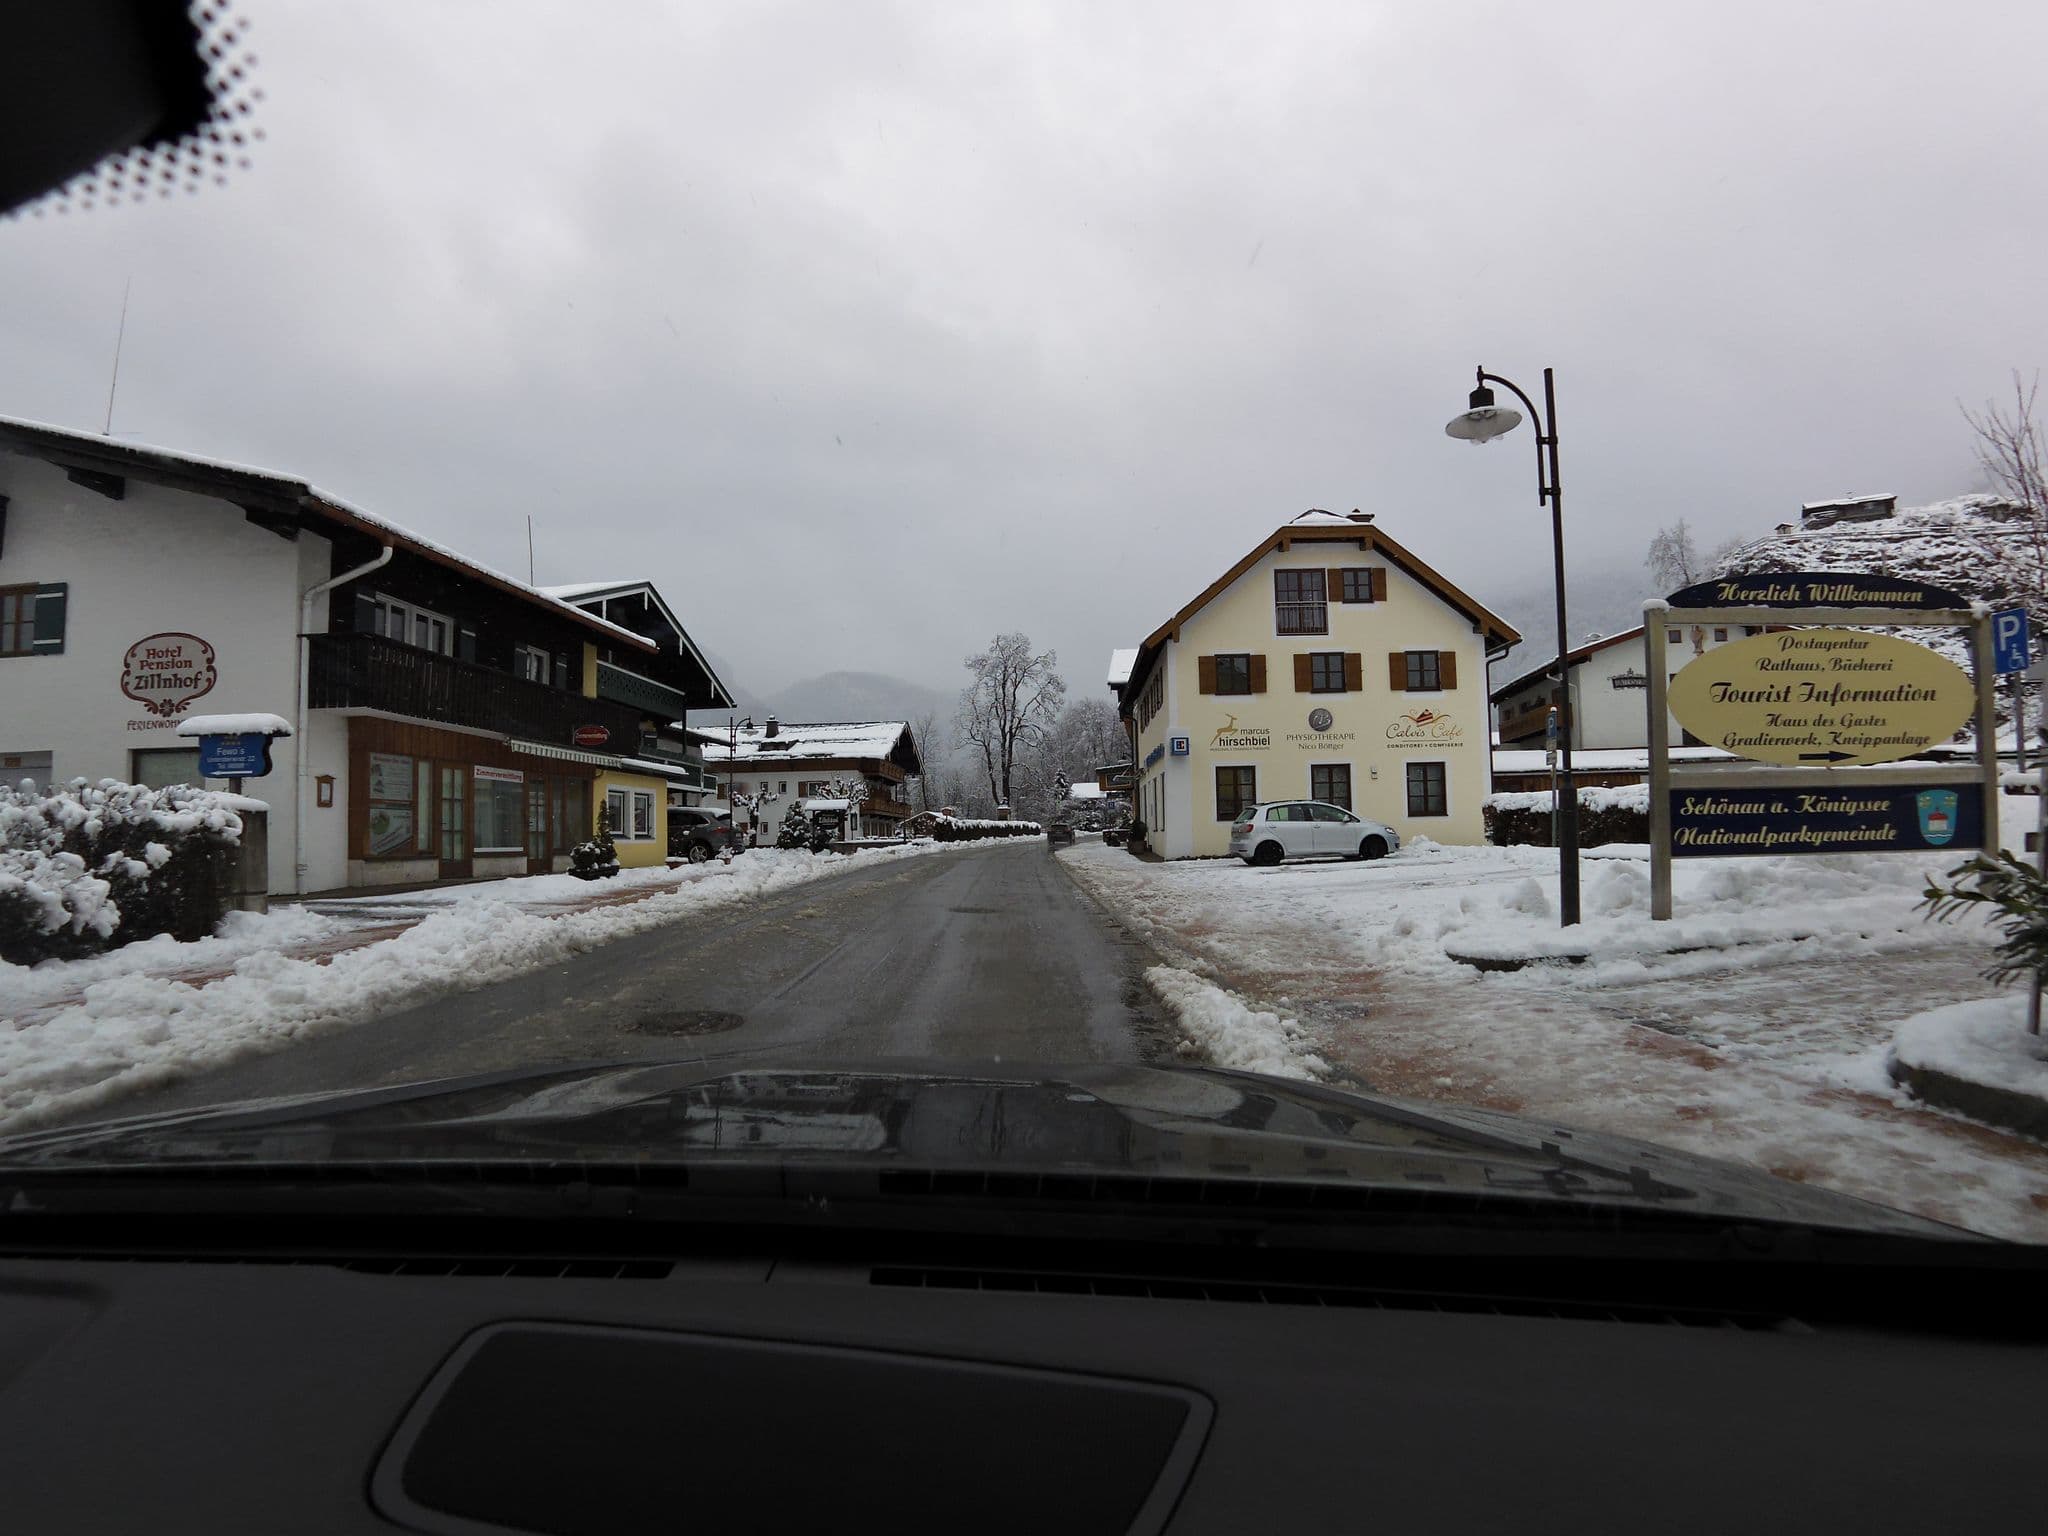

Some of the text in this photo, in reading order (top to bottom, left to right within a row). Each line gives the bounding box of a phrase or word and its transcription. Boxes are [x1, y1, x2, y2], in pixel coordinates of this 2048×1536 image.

[1717, 583, 1924, 603] Herzlich Willkommen
[1999, 615, 2020, 651] P
[1778, 635, 1870, 652] Postagentur
[146, 646, 182, 659] Hotel
[139, 659, 193, 670] Pension
[1755, 657, 1893, 673] Rathaus, Bücherei
[133, 671, 203, 690] Zillnhof
[1709, 681, 1937, 707] Tourist Information
[1766, 713, 1887, 729] Haus des Gastes
[1219, 735, 1270, 747] hirschbiel
[1286, 732, 1356, 742] PHYSIOTHERAPIE
[1723, 732, 1931, 749] Gradierwerk, Kneippanlage
[1680, 795, 1891, 816] Schönau a. Königssee
[1674, 823, 1897, 848] Nationalparkgemeinde
